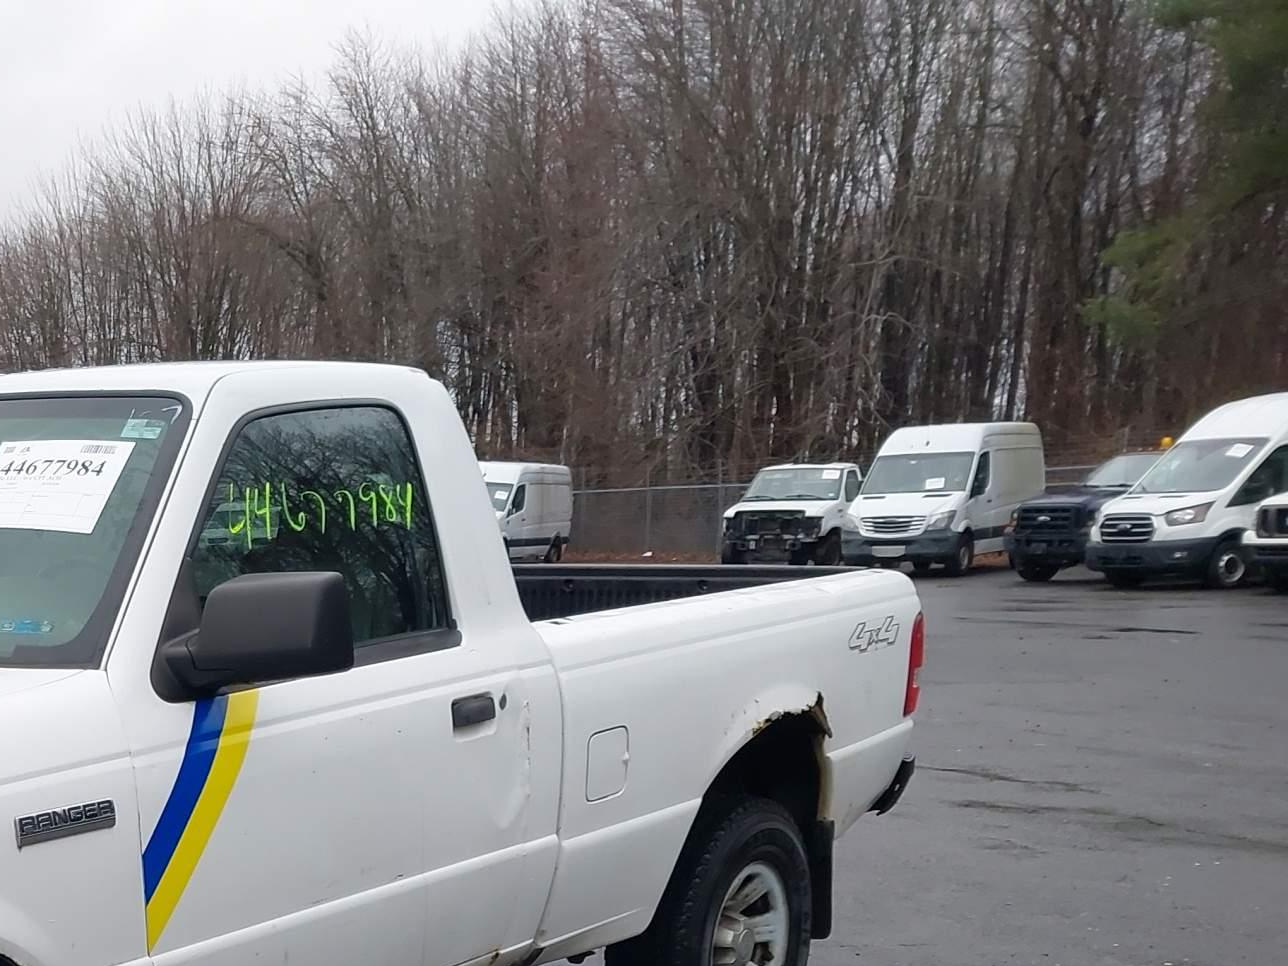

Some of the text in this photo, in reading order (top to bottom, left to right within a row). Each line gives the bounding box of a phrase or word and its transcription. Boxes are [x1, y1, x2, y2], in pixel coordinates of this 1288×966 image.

[0, 459, 107, 477] 44677984
[228, 482, 413, 550] 44677984
[848, 615, 900, 653] 4x4
[18, 799, 115, 834] RANGER
